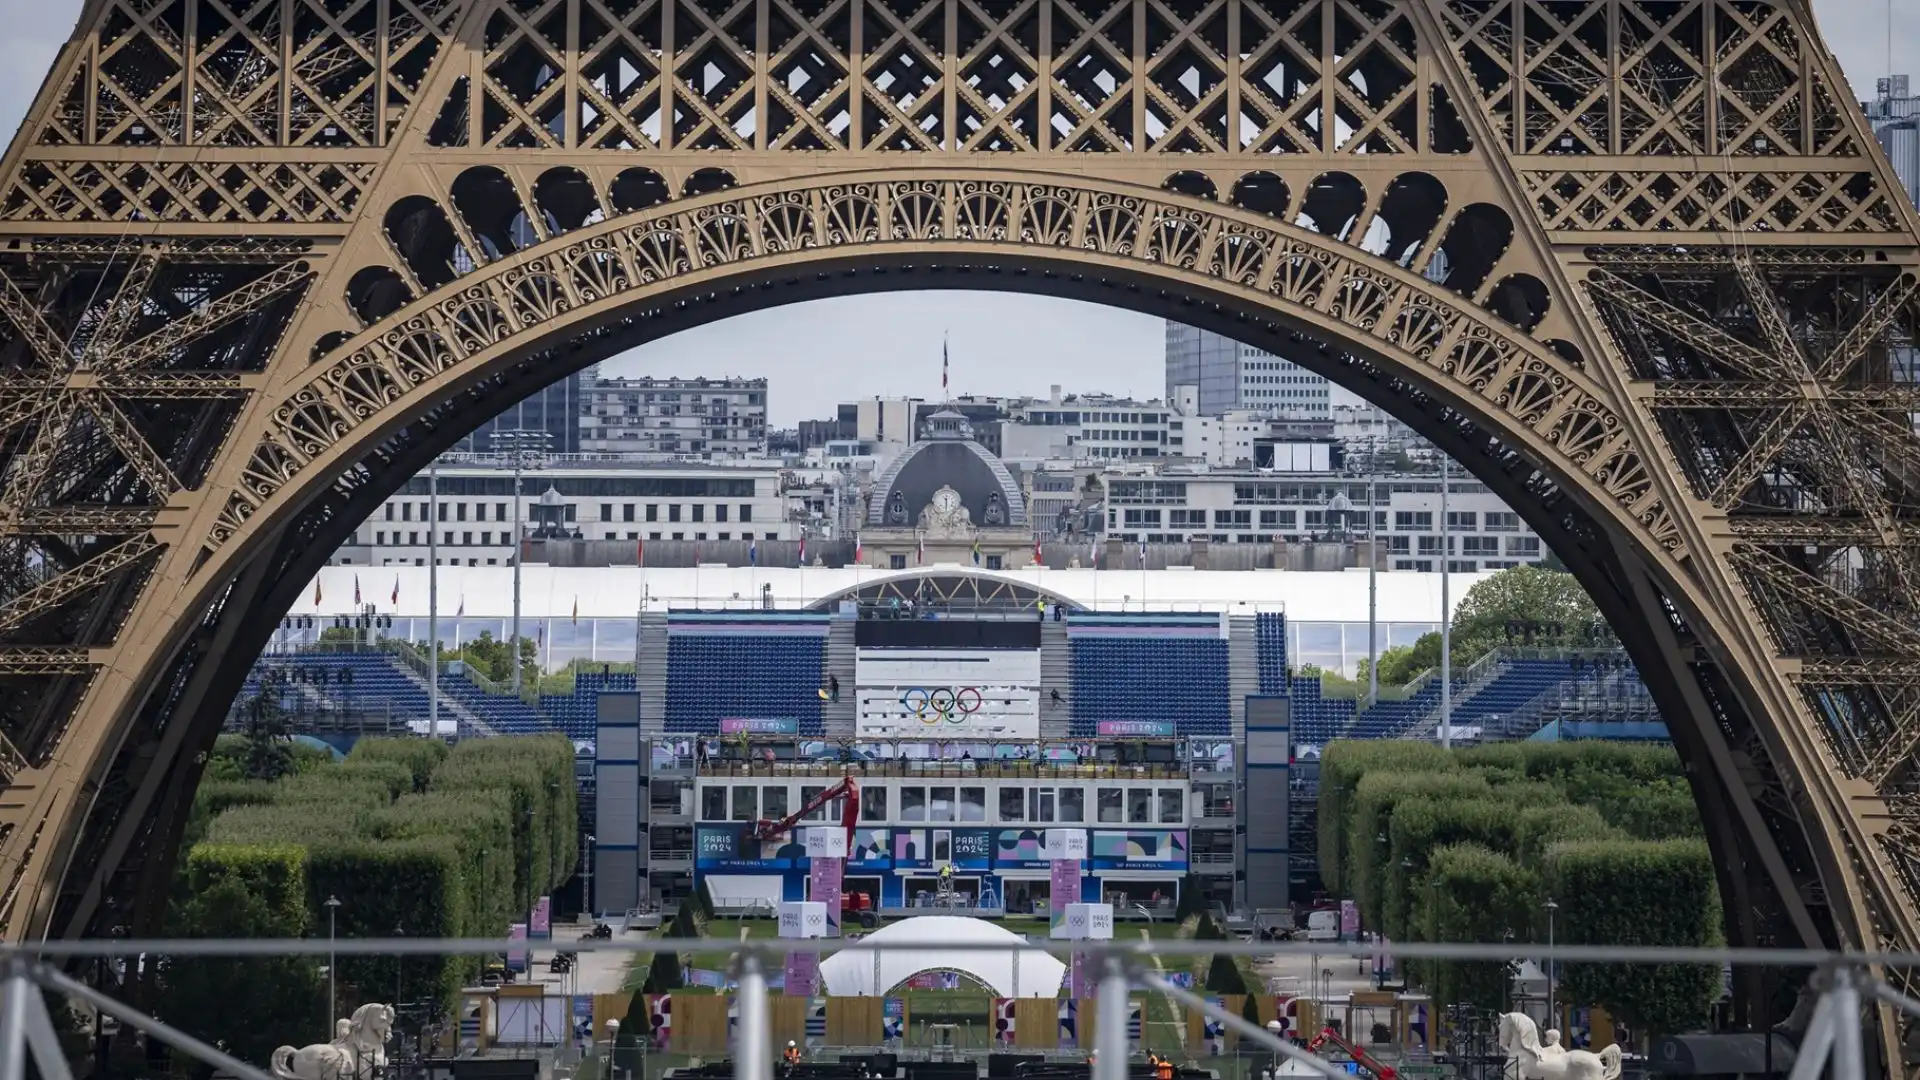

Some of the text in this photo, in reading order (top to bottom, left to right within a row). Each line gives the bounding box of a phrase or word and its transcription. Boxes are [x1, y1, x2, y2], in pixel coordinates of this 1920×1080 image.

[703, 835, 731, 843] PARIS
[955, 836, 983, 845] PARIS
[703, 843, 731, 852] 2024
[955, 845, 983, 853] 2024
